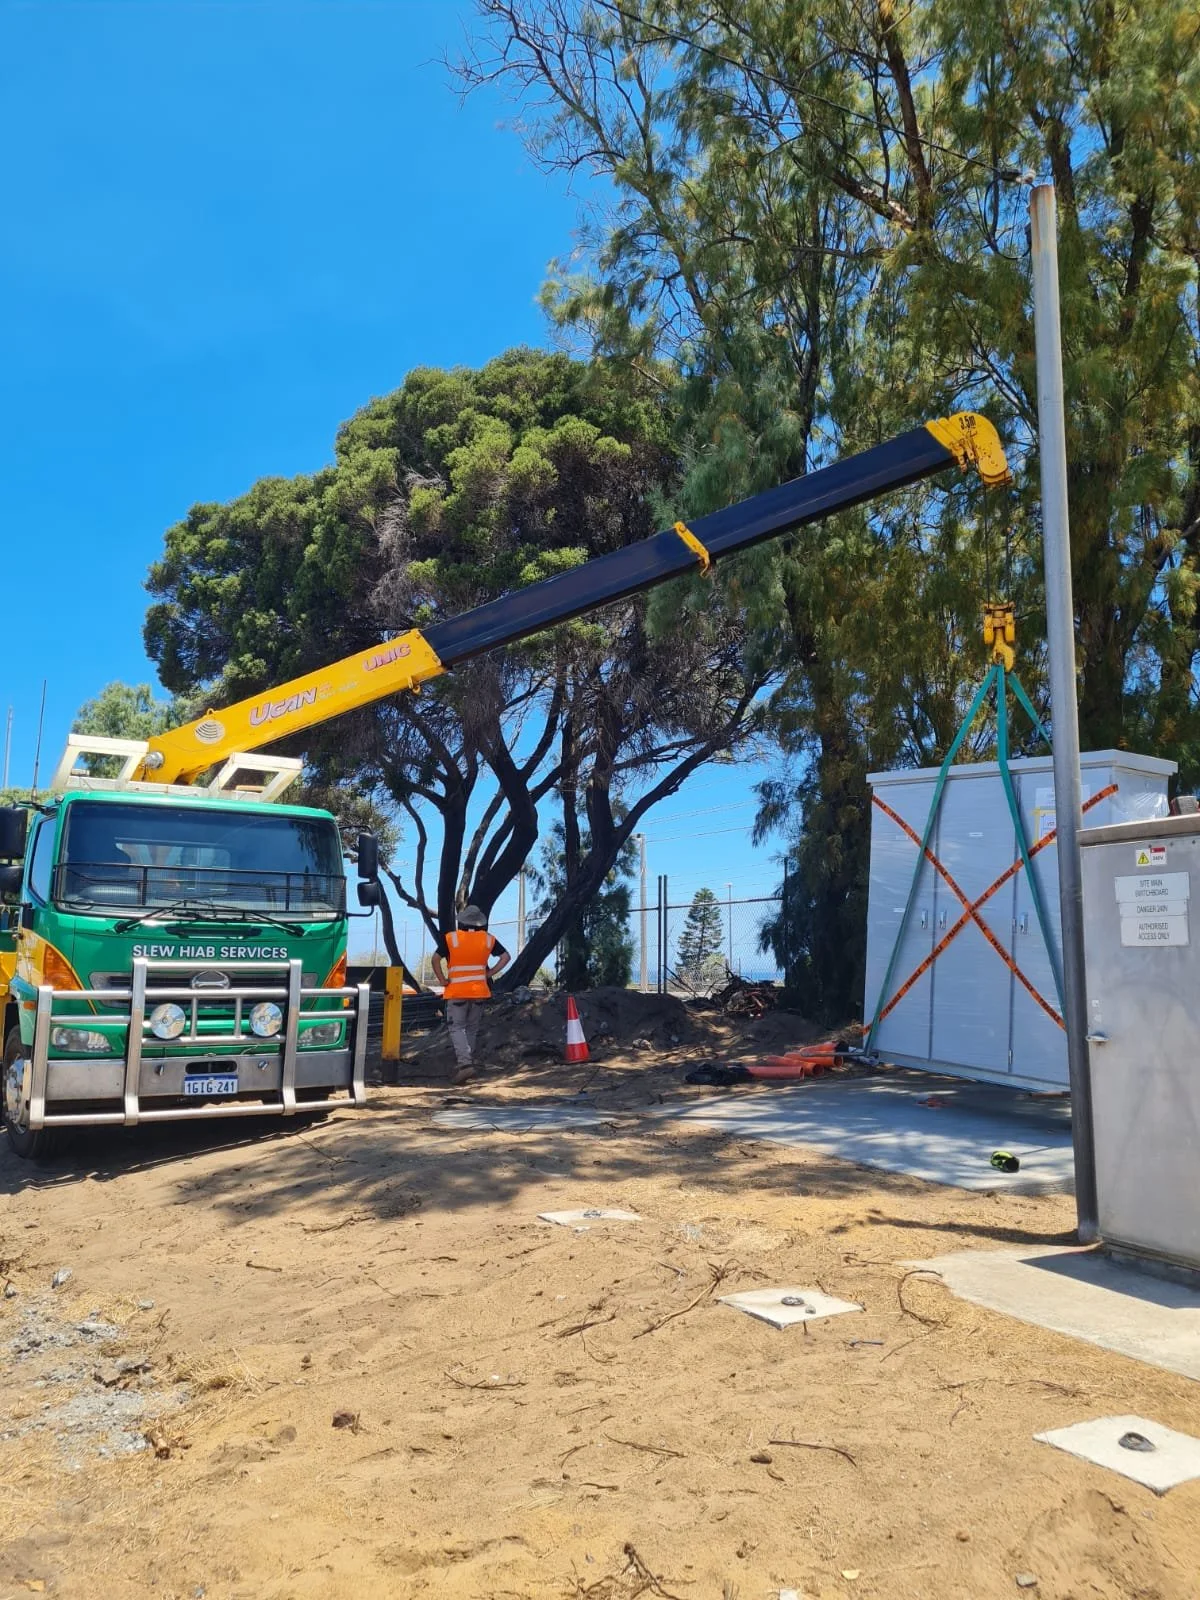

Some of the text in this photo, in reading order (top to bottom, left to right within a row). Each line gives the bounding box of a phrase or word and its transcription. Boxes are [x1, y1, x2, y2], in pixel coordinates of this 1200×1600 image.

[362, 643, 411, 673] UNIC
[1136, 905, 1156, 914] DANGER
[1138, 922, 1169, 930] AUTHORISED
[1138, 931, 1170, 941] ACCESS ONLY
[132, 944, 288, 959] SLEW HIAB SERVICES
